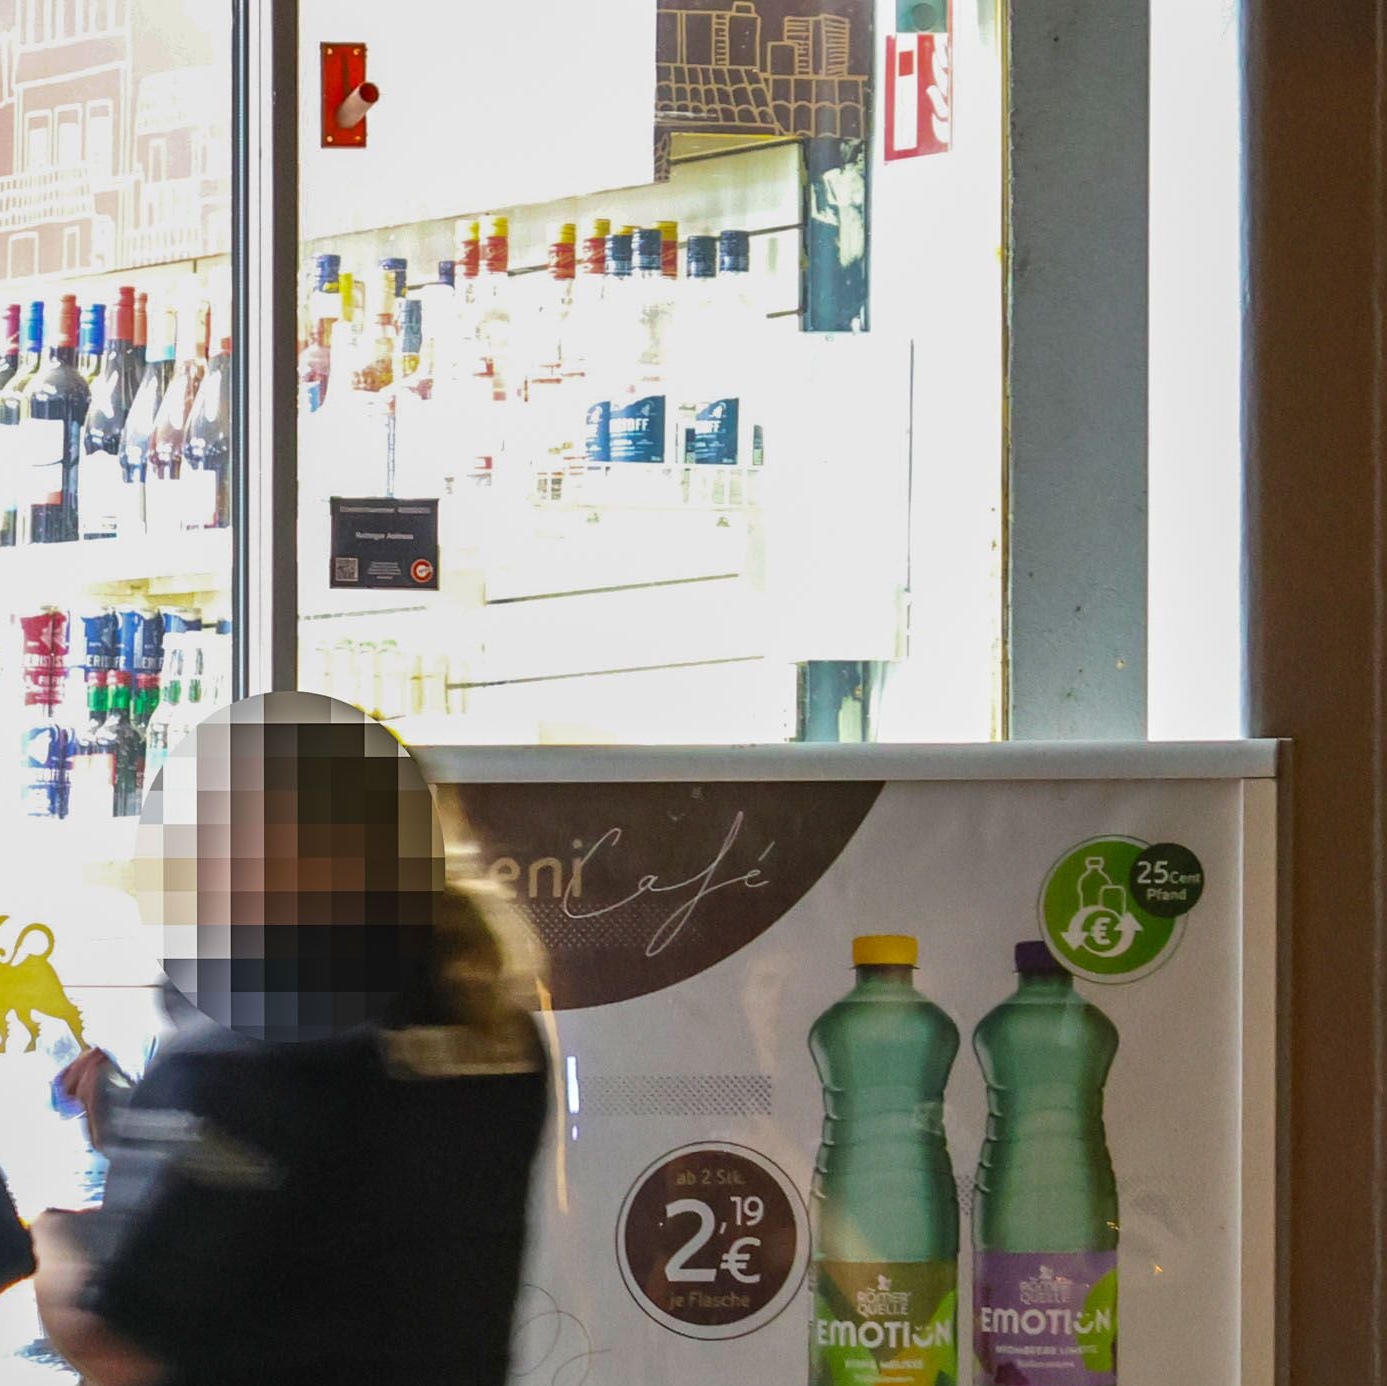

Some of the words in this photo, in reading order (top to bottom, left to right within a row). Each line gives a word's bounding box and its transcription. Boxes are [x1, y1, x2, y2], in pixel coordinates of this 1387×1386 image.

[1137, 861, 1168, 884] 25
[488, 838, 583, 898] eni
[563, 810, 775, 957] Café
[1146, 888, 1187, 900] Pfand
[677, 1171, 697, 1185] ab
[701, 1170, 712, 1184] 2
[664, 1196, 765, 1282] 2,19
[720, 1236, 761, 1284] €
[670, 1294, 684, 1310] je
[689, 1291, 751, 1308] Flasche
